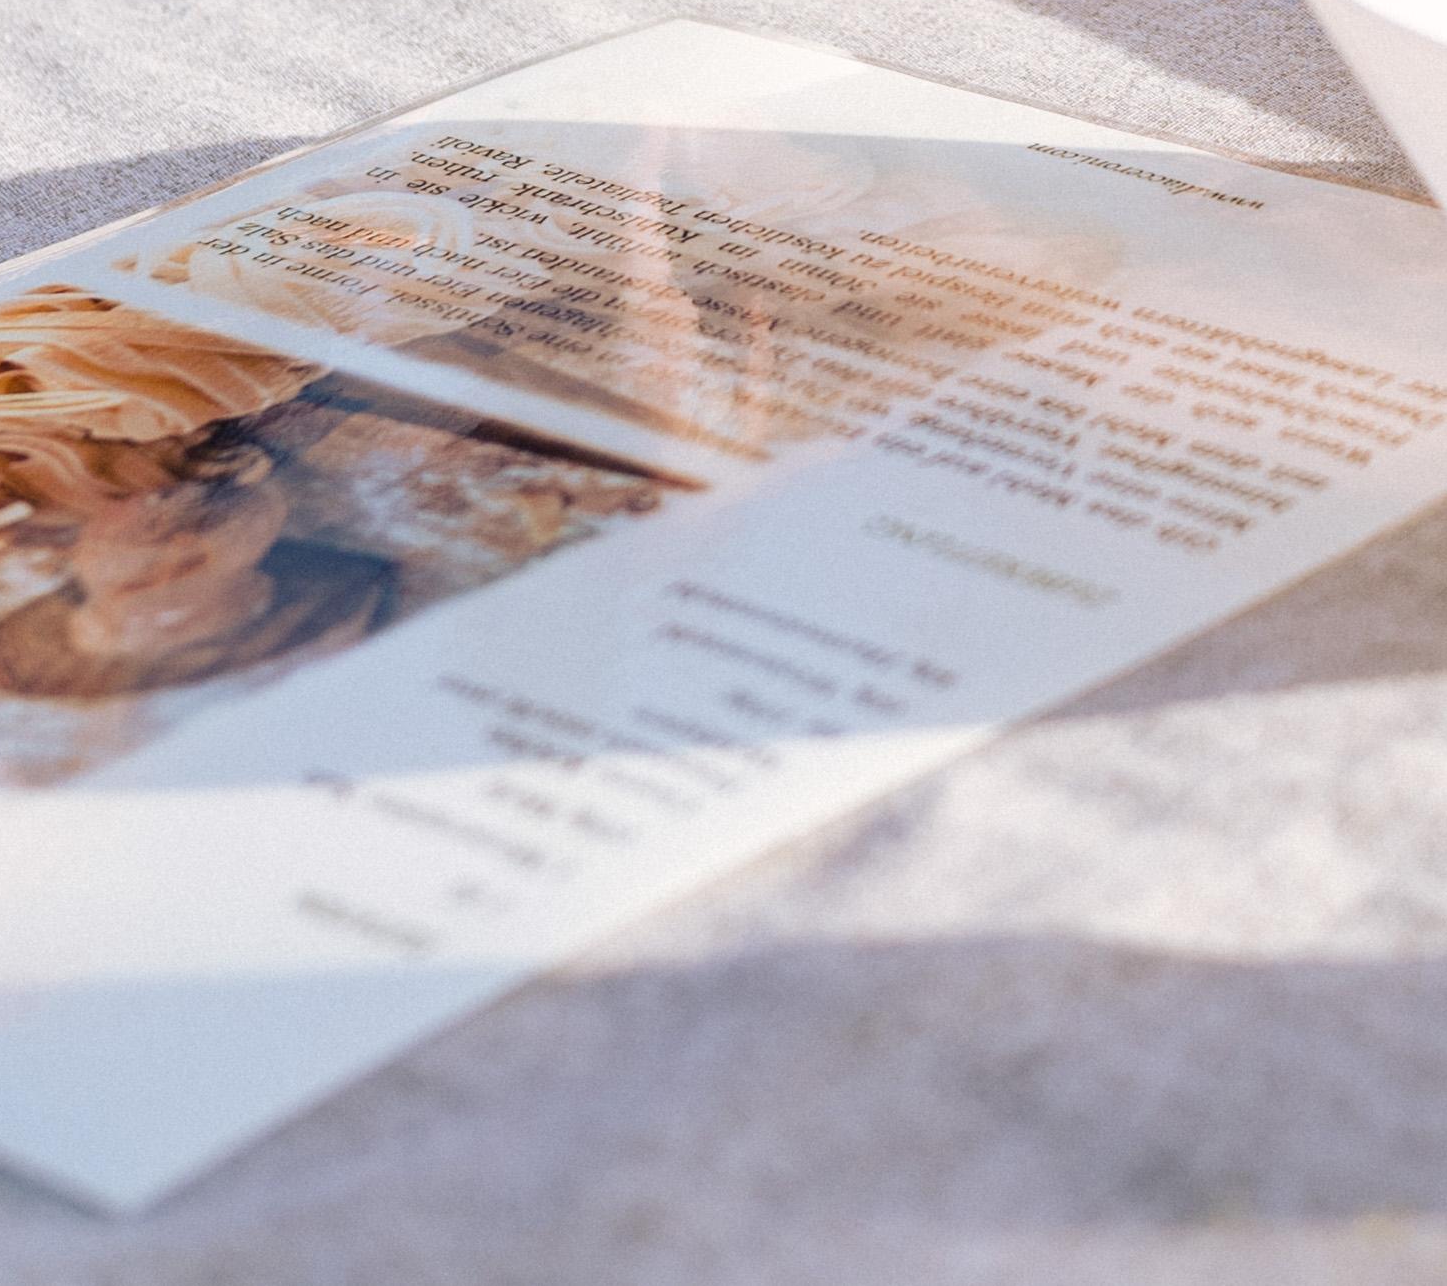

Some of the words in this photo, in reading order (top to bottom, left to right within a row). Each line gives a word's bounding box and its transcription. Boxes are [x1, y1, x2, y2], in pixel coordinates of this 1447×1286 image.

[429, 135, 534, 169] Ravioli
[363, 166, 402, 184] in
[406, 151, 500, 183] ruhen.
[1025, 142, 1264, 210] www.diacceroni.com
[403, 178, 452, 196] sie
[538, 162, 695, 216] Tagliatelle,
[274, 206, 351, 233] nach
[455, 193, 550, 225] wickle
[194, 237, 251, 256] der
[235, 222, 301, 246] Salz
[342, 226, 410, 249] und
[471, 232, 520, 253] ist.
[561, 221, 684, 262] anfühlt,
[691, 209, 846, 260] köstlichen
[250, 252, 288, 267] in
[298, 239, 356, 260] das
[409, 243, 488, 271] nach
[715, 241, 761, 260] im
[847, 253, 893, 270] zu
[282, 261, 380, 295] Forme
[348, 254, 418, 278] und
[483, 265, 553, 290] Eier
[776, 258, 877, 293] 30min
[853, 229, 1121, 311] weiterverarbeiten.
[414, 274, 483, 299] Eier
[549, 284, 602, 303] die
[689, 260, 826, 303] elastisch
[383, 289, 526, 337] Schüssel.
[827, 300, 904, 332] und
[525, 331, 594, 355] eine
